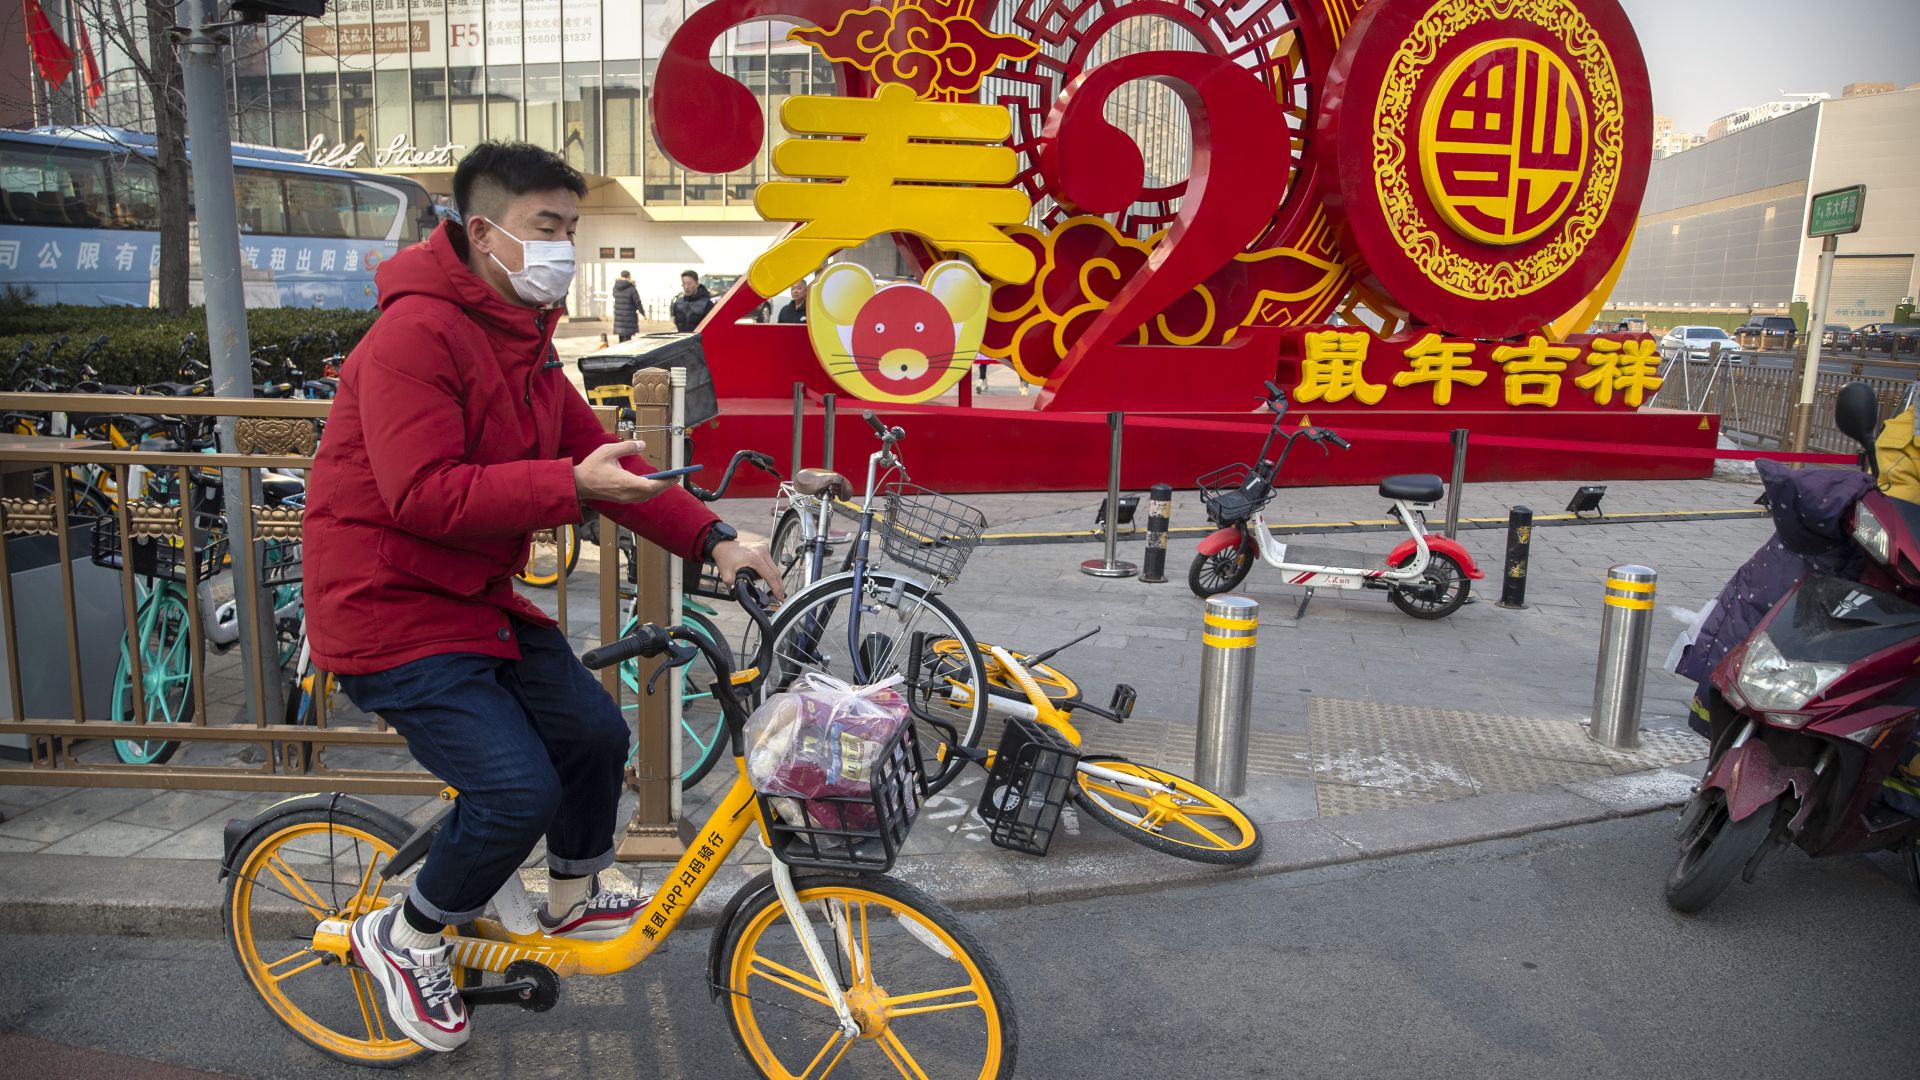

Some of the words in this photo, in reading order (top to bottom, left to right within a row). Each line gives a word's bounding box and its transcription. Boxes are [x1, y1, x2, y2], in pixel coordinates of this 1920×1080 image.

[449, 24, 480, 48] F5
[305, 133, 366, 167] Silk
[374, 133, 467, 168] Street
[1293, 329, 1664, 408] 鼠年吉祥
[641, 830, 724, 941] 美团APP扫码骑行
